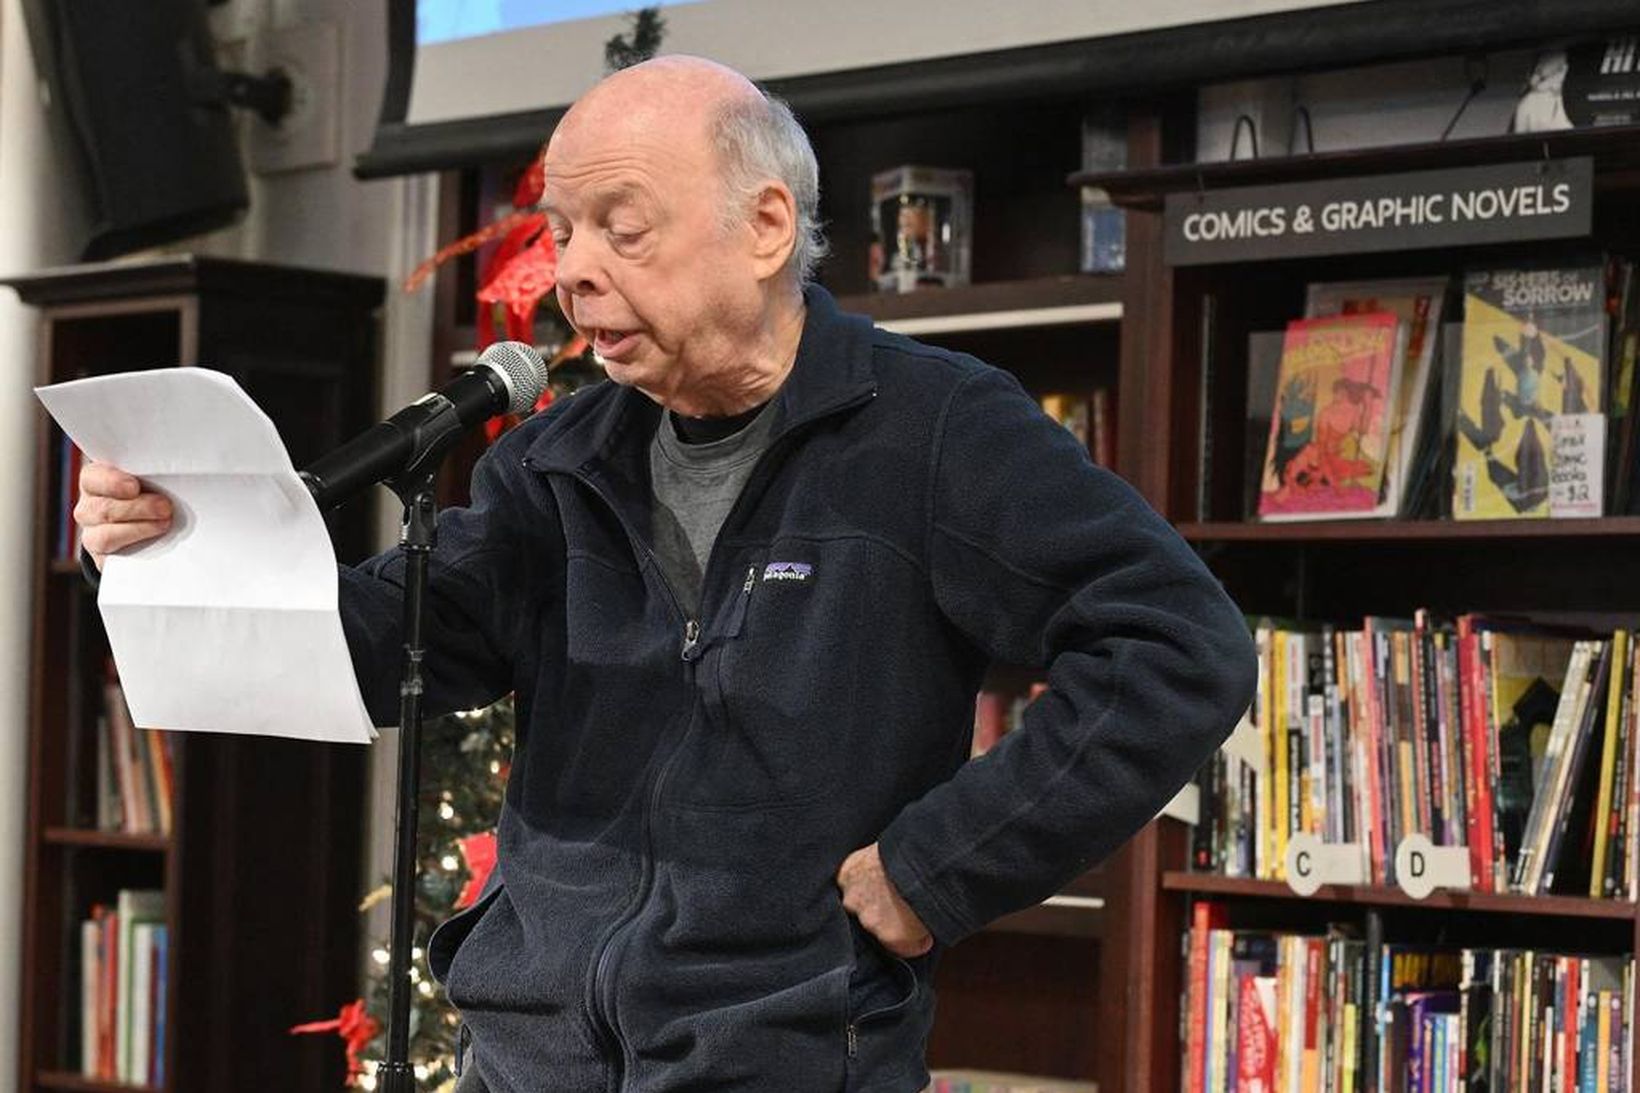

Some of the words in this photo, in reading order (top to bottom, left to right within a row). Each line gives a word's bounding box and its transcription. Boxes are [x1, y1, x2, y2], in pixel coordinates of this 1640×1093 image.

[1184, 206, 1286, 241] COMICS
[1293, 206, 1314, 234] &
[1321, 195, 1444, 232] GRAPHIC
[1451, 184, 1571, 221] NOVELS
[1502, 282, 1595, 307] SORROW
[1296, 851, 1311, 877] C
[1410, 851, 1425, 877] D
